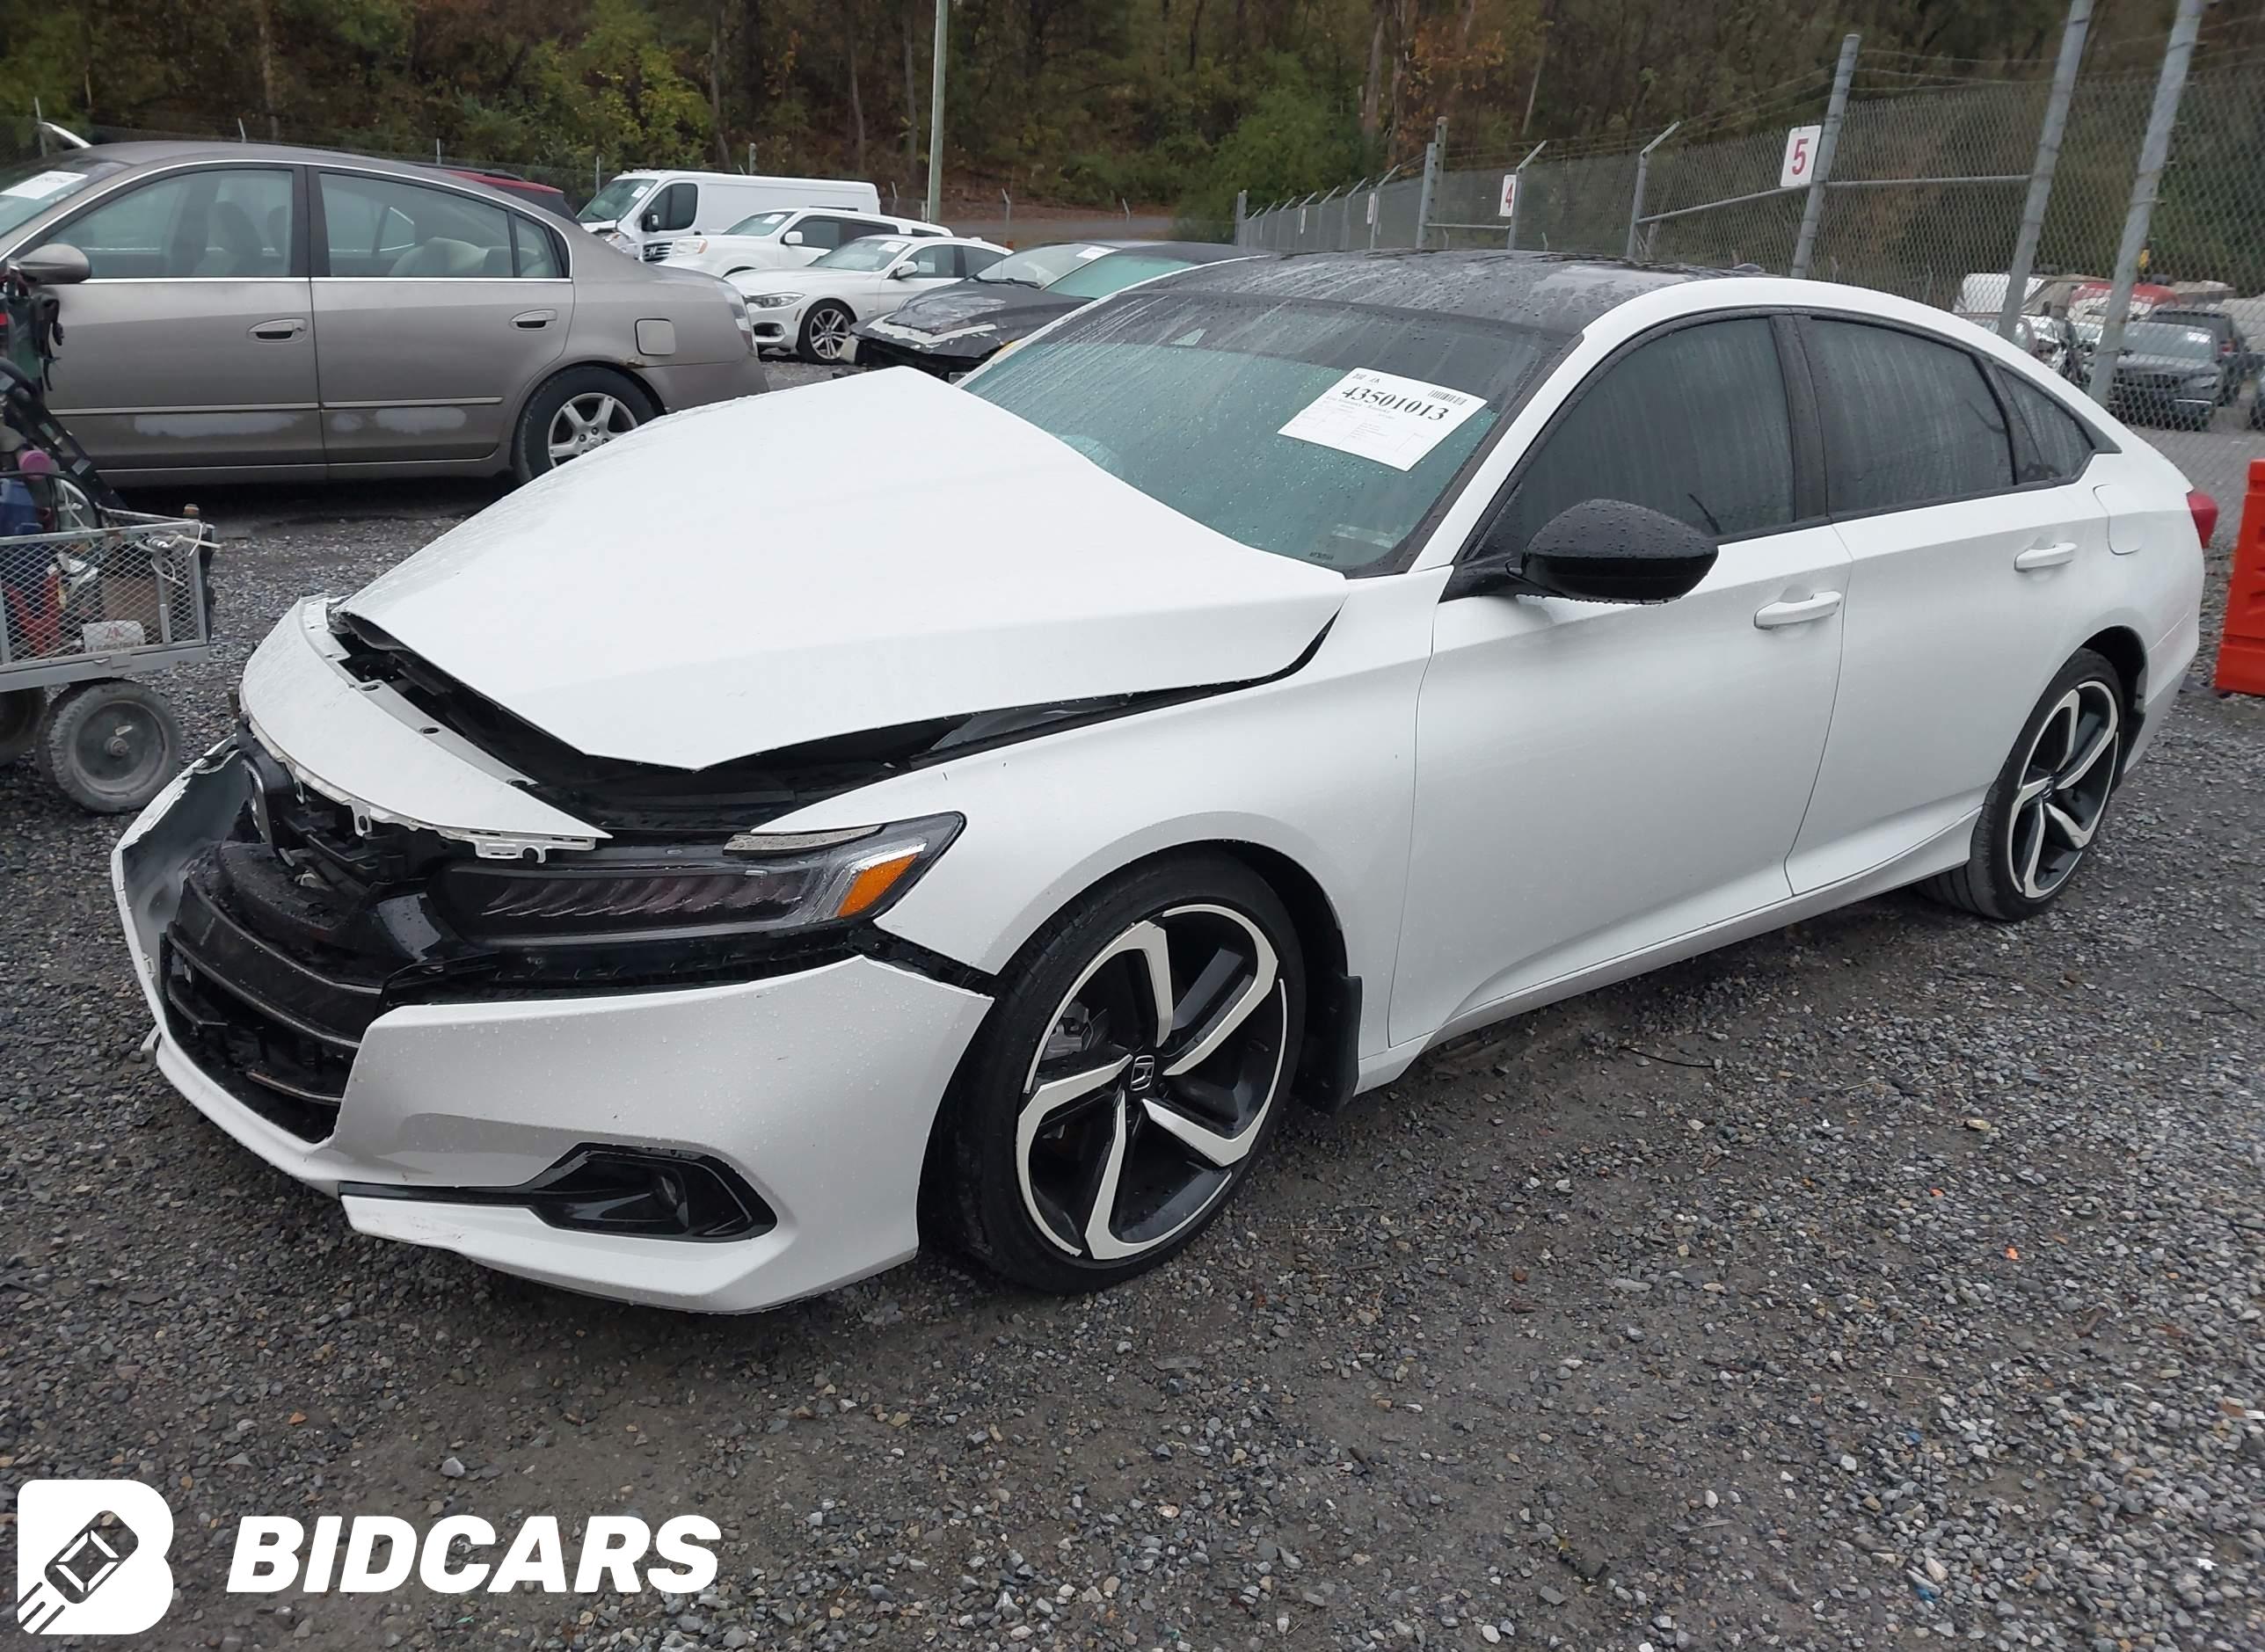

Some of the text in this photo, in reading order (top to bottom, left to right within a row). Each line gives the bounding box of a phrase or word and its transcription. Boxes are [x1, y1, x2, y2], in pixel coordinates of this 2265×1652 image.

[1792, 137, 1809, 175] 5
[1505, 182, 1514, 209] 4
[1342, 386, 1450, 421] 43501013
